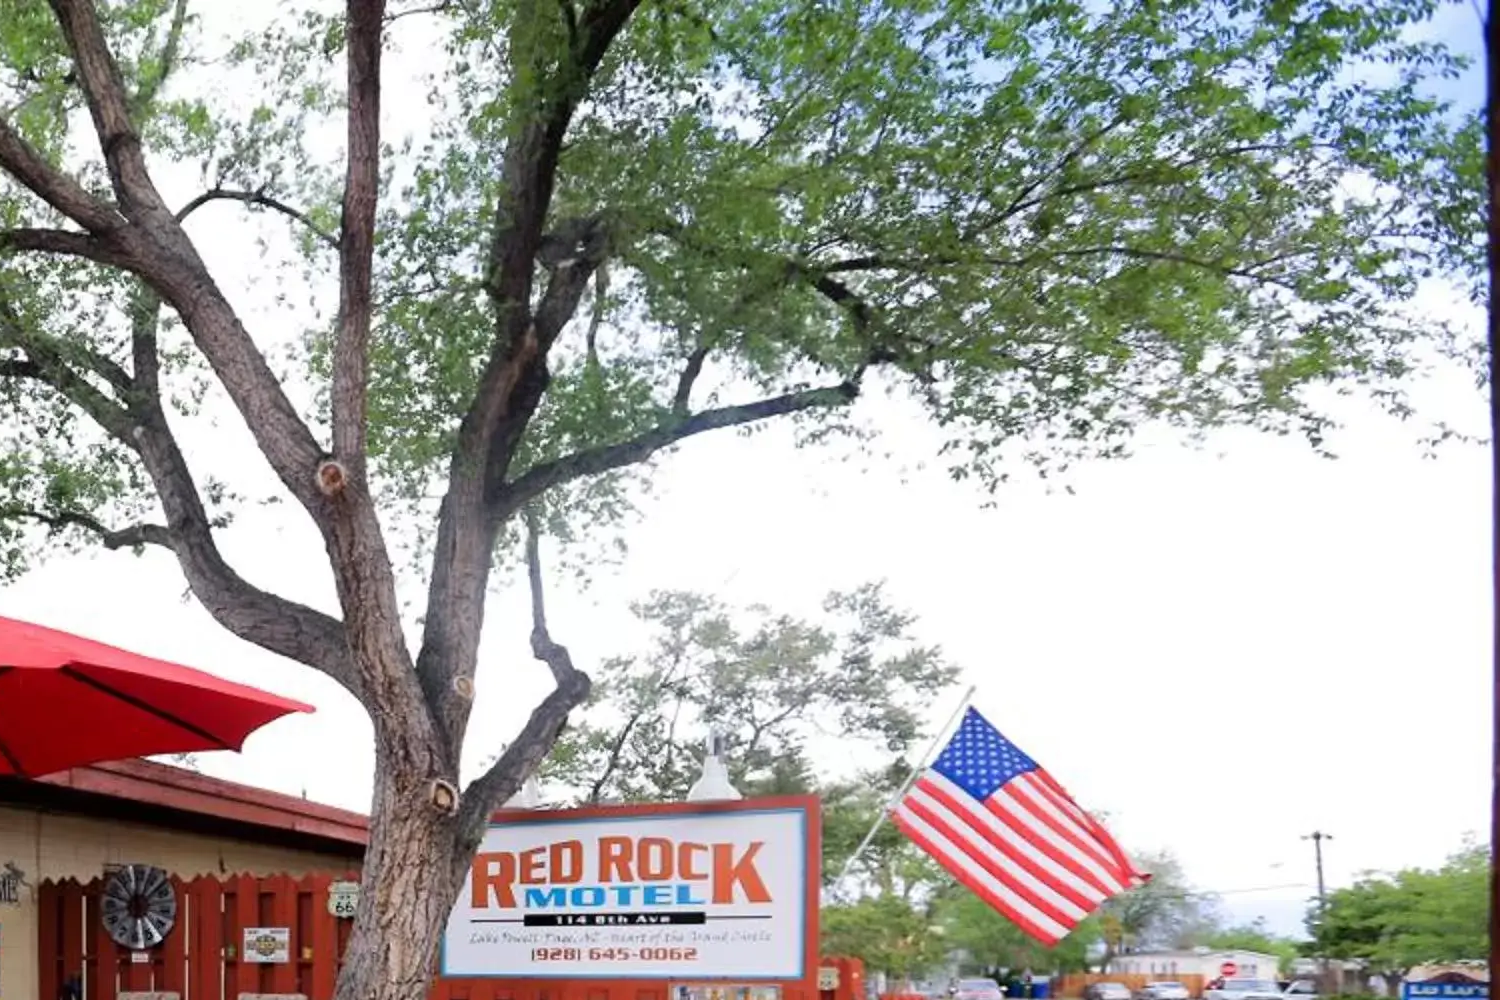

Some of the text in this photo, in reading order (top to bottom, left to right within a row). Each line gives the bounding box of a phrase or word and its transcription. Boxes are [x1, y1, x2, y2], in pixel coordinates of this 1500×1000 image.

[470, 835, 773, 908] RED ROCK
[525, 885, 706, 909] MOTEL
[335, 901, 354, 913] 66
[555, 913, 671, 925] 114 8th Ave
[531, 947, 698, 962] (928) 645-0062
